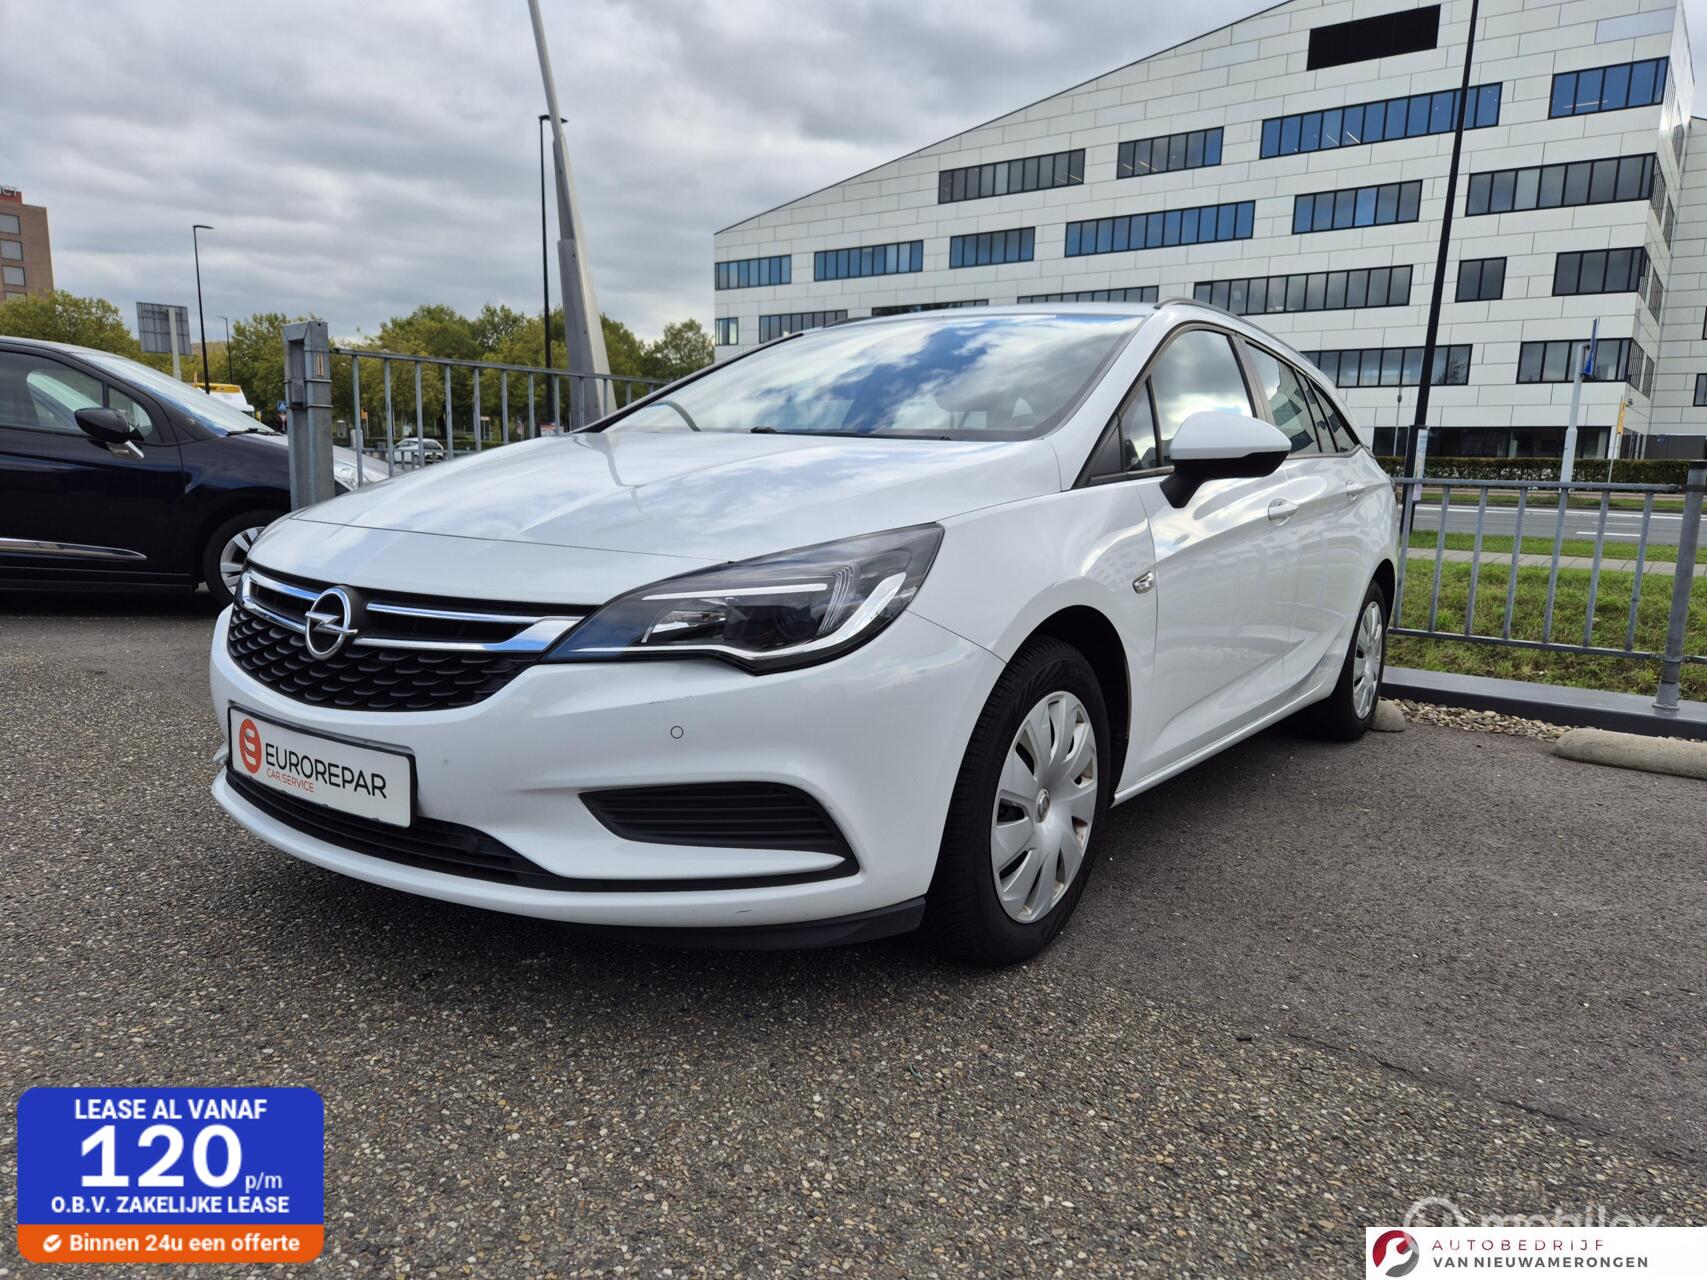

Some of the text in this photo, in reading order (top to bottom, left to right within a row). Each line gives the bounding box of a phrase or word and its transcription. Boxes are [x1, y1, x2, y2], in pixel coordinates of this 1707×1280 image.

[265, 742, 387, 799] EUROREPAR
[266, 767, 314, 793] CAR SERVICE
